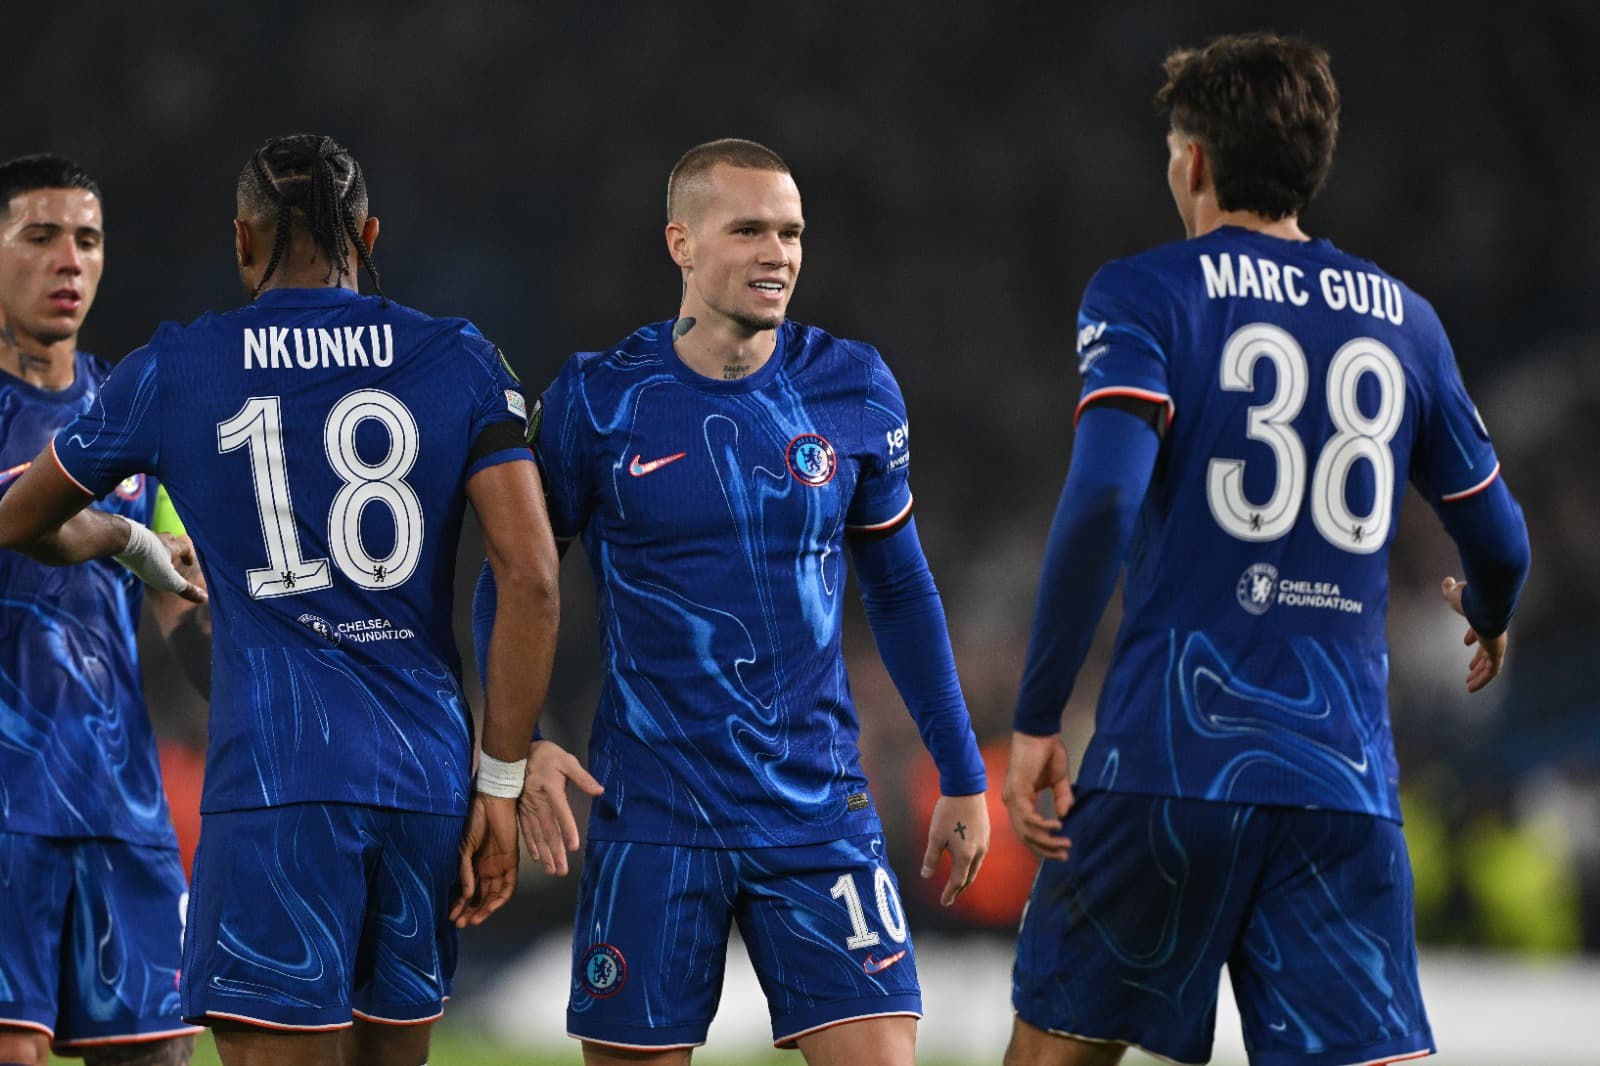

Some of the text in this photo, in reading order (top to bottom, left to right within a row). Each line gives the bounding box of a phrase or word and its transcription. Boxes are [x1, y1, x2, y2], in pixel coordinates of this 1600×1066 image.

[1200, 253, 1404, 326] MARC GUIU
[244, 324, 394, 369] NKUNKU
[1206, 322, 1406, 554] 38
[217, 388, 425, 600] 18
[1278, 593, 1363, 614] FOUNDATION
[1280, 580, 1340, 596] CHELSEA
[337, 619, 391, 633] CHELSEA
[829, 866, 907, 951] 10
